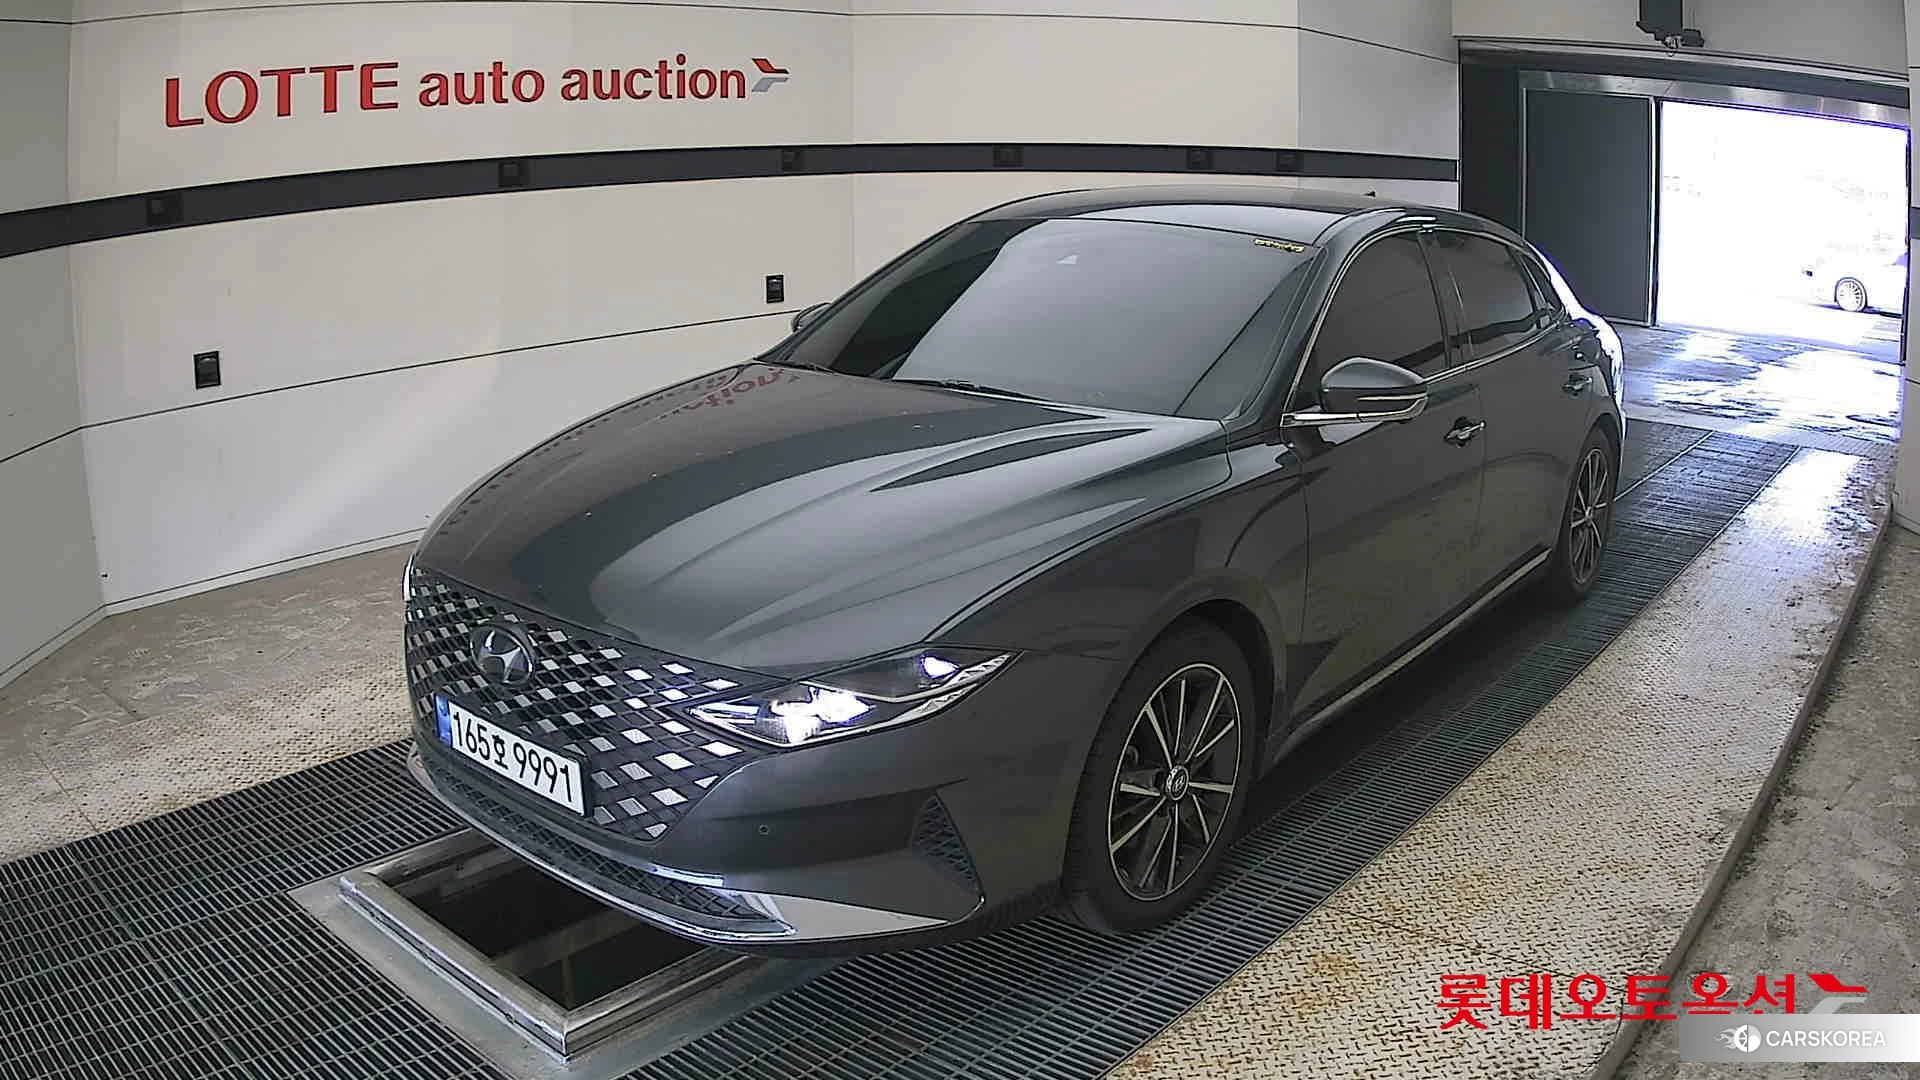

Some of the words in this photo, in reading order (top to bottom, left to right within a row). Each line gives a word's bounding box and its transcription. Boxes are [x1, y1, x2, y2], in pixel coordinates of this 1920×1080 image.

[164, 62, 399, 128] LOTTE
[418, 61, 545, 107] auto
[561, 53, 747, 100] auction
